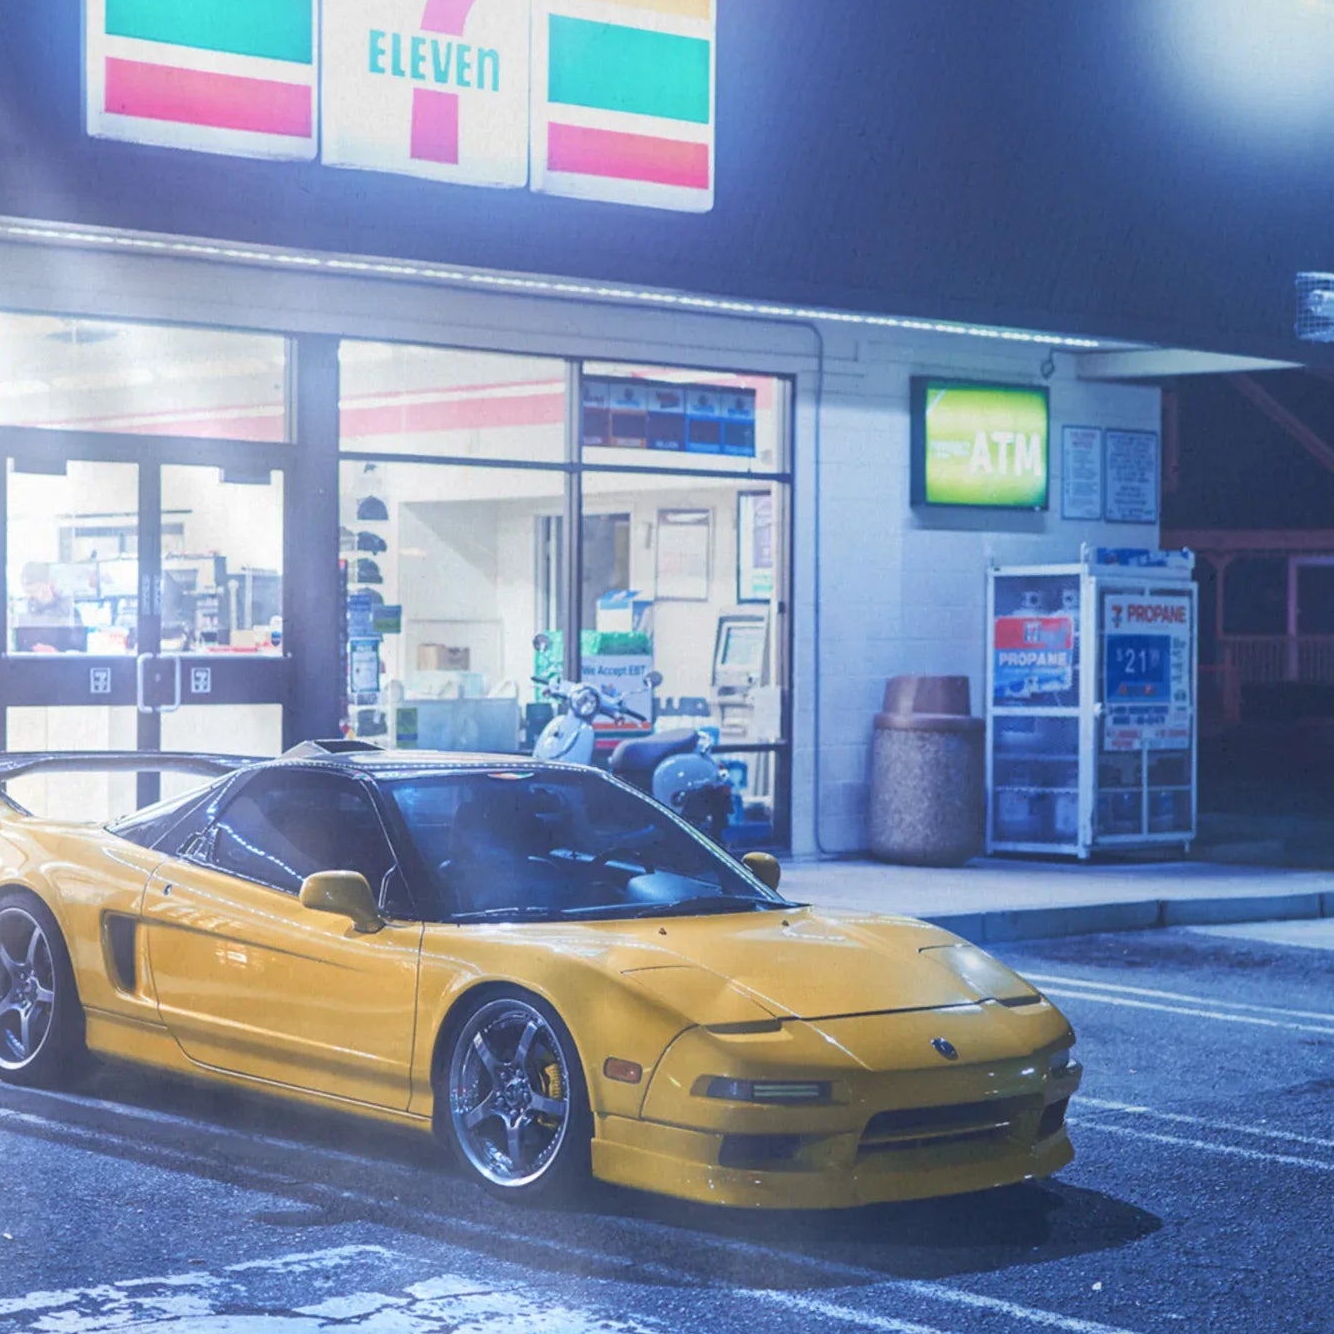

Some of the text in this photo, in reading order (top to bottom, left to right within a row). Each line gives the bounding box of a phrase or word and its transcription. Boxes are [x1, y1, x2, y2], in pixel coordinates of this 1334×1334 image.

[968, 428, 1043, 476] ATM
[1127, 603, 1186, 623] PROPANE
[999, 652, 1067, 667] PROPANE
